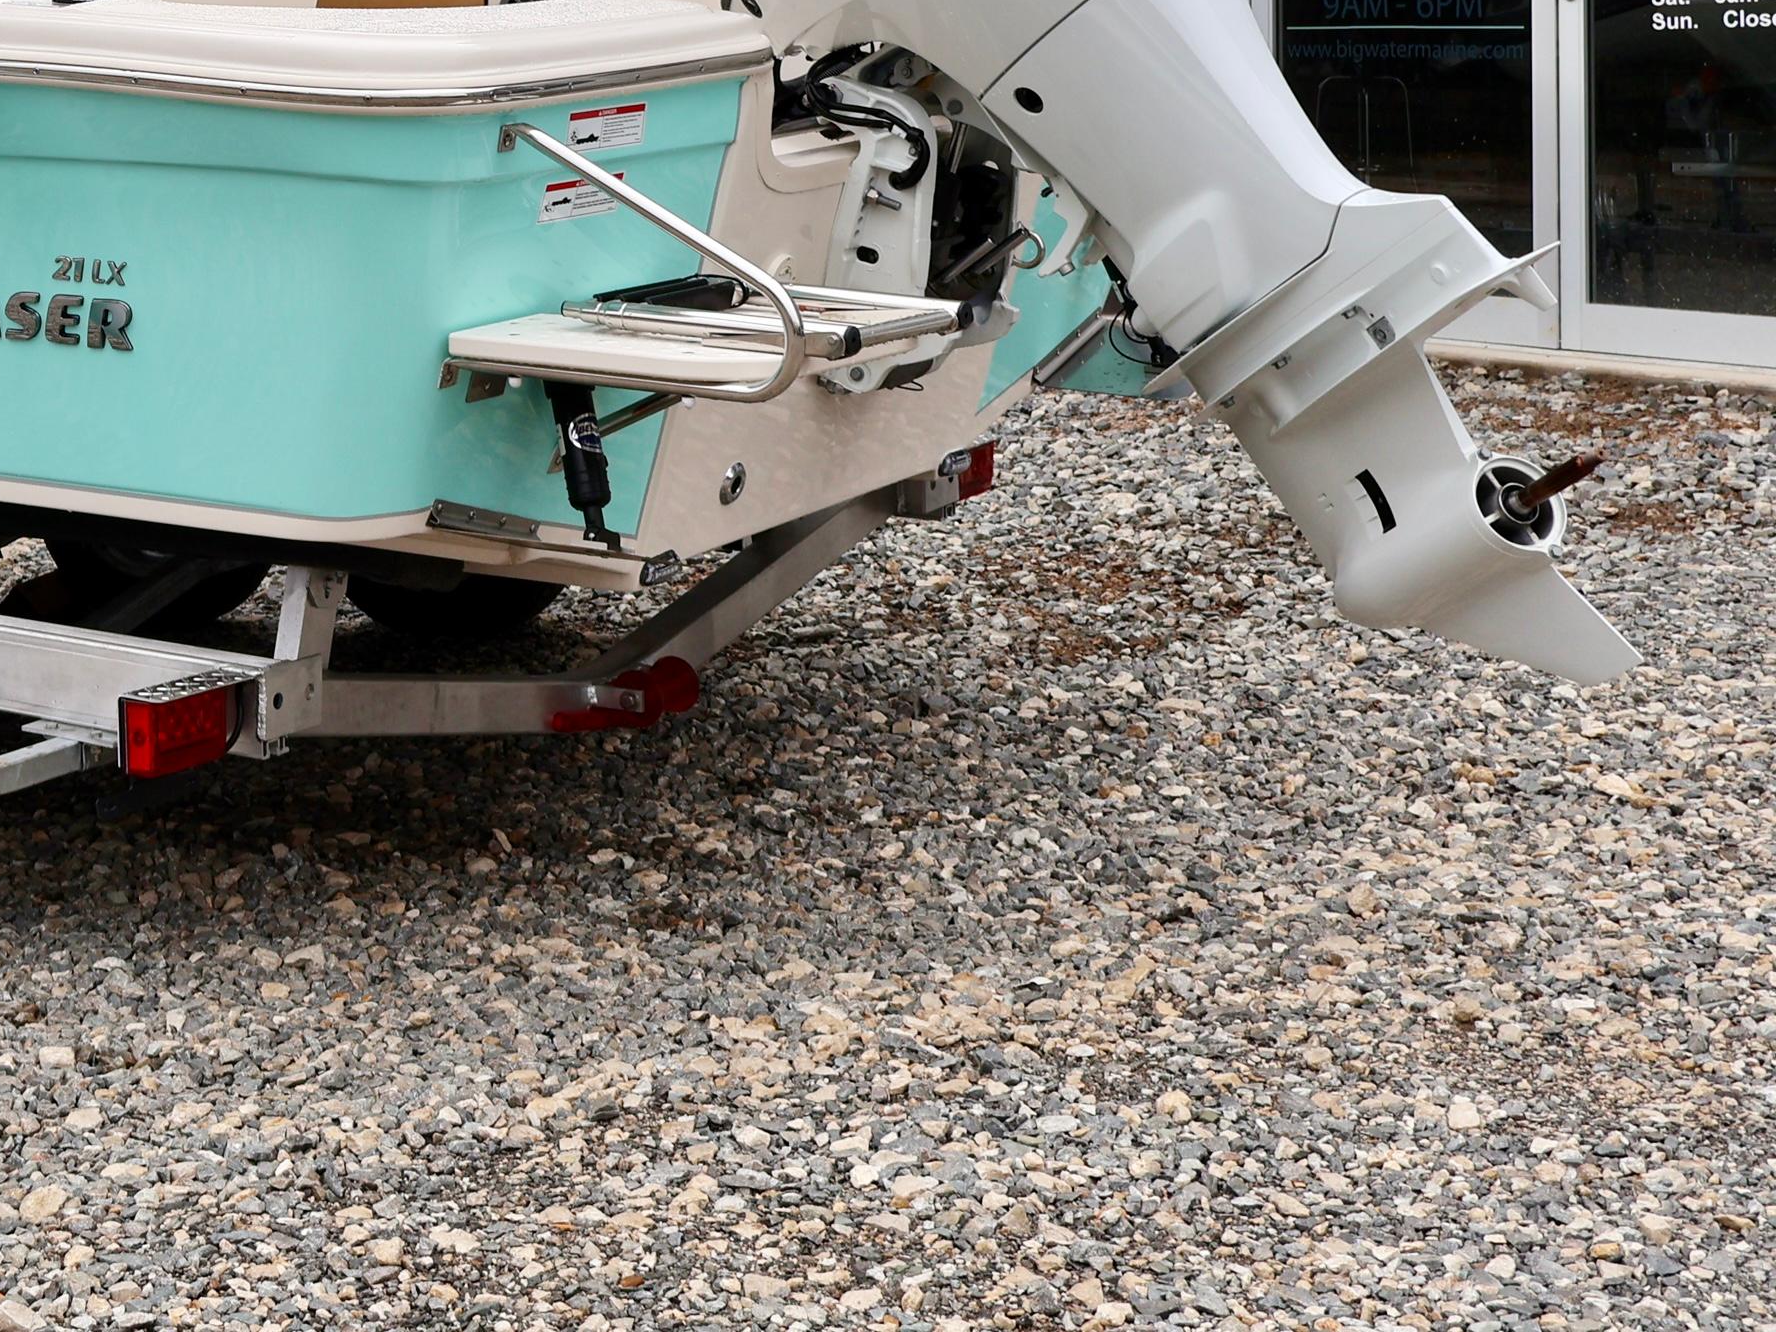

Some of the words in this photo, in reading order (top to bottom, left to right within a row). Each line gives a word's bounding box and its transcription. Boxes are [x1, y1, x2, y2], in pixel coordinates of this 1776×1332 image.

[1652, 12, 1699, 30] Sun.
[1287, 40, 1525, 63] www.bigwatermarine.com
[52, 255, 84, 282] 21
[92, 259, 128, 287] LX
